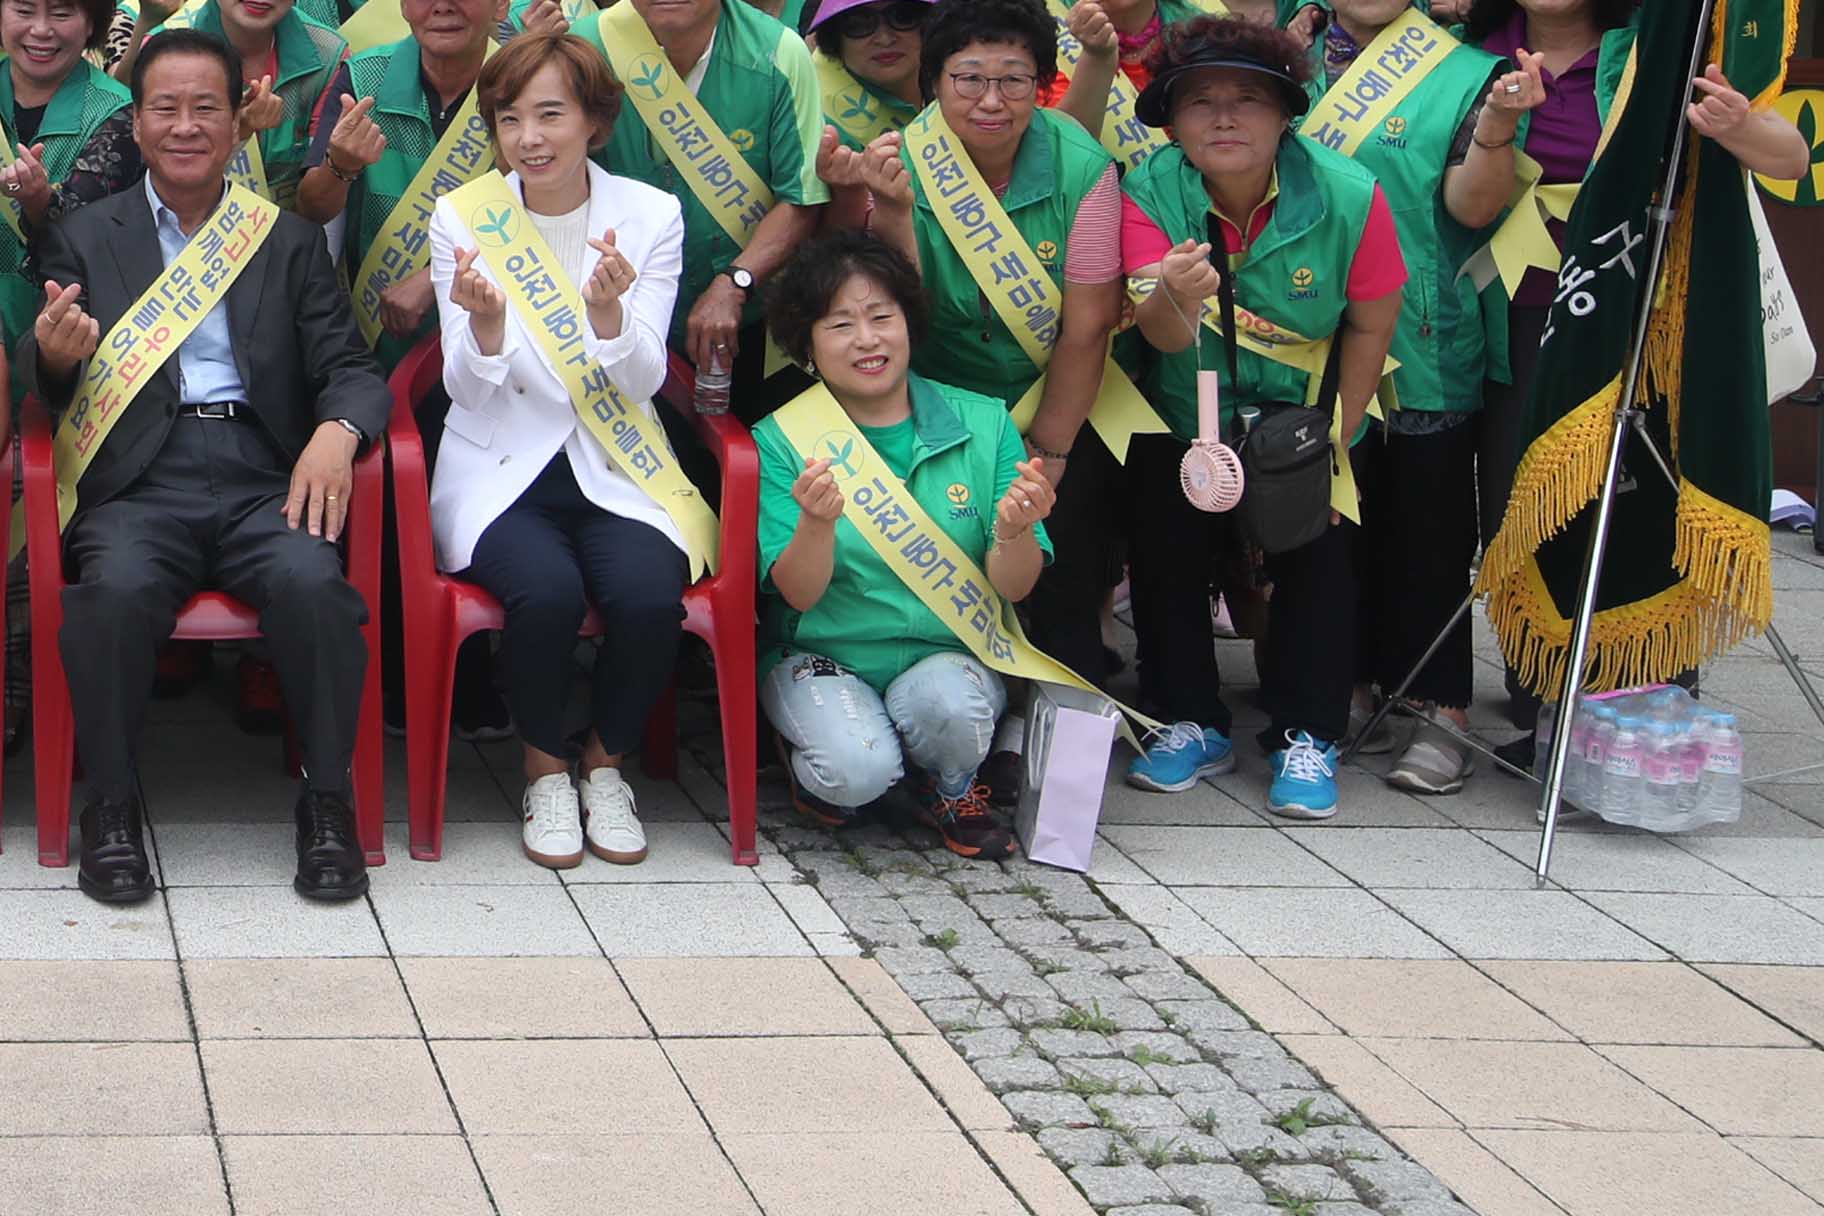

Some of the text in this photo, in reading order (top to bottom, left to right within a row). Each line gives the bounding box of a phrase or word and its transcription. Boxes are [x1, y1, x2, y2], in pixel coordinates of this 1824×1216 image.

[1376, 135, 1408, 150] SMU
[1287, 288, 1320, 302] SMU
[949, 506, 979, 521] SMU
